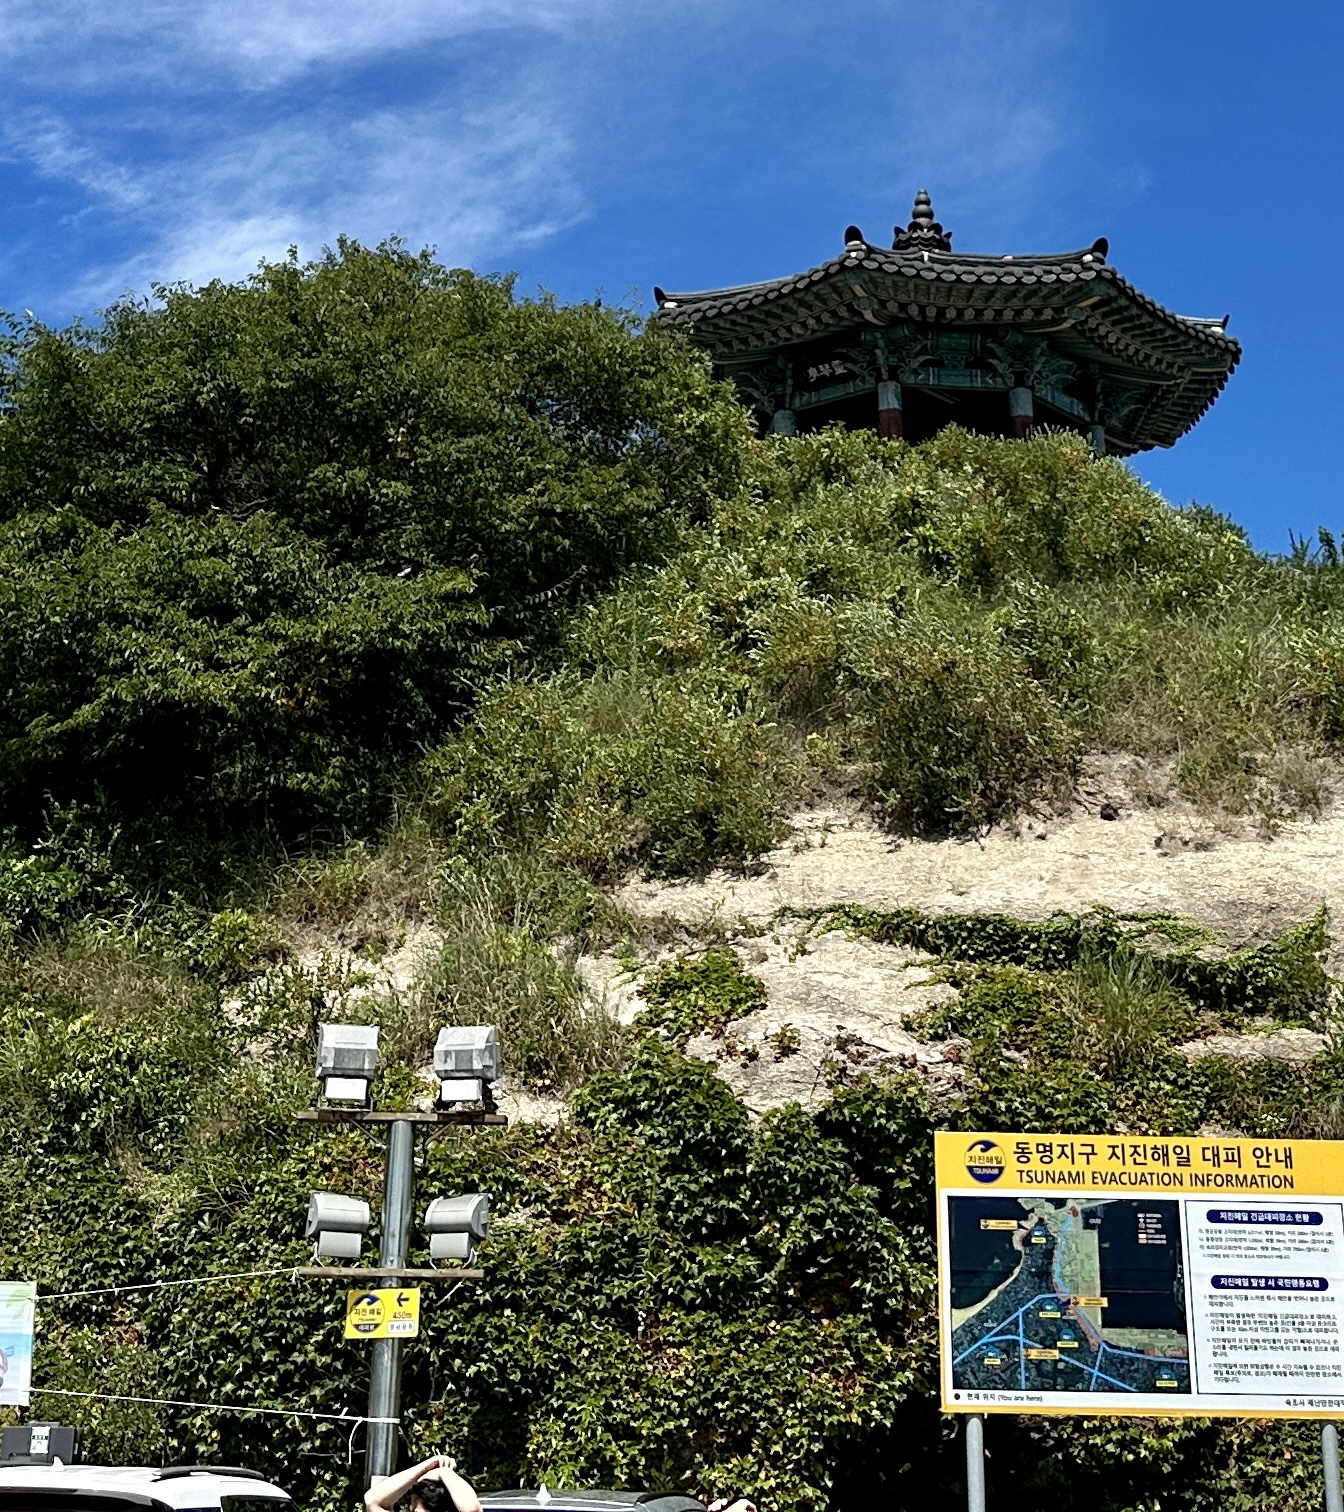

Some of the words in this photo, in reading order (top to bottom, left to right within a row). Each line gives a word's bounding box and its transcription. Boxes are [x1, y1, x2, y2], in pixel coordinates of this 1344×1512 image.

[968, 1155, 1003, 1165] 지진해일
[1013, 1141, 1098, 1165] 동명지구
[1107, 1143, 1192, 1168] 지진해일
[1201, 1145, 1242, 1169] 대피
[1252, 1146, 1294, 1170] 안내
[1016, 1169, 1086, 1185] TSUNAMI
[1091, 1170, 1184, 1187] EVACUATION
[1189, 1172, 1295, 1189] INFORMATION
